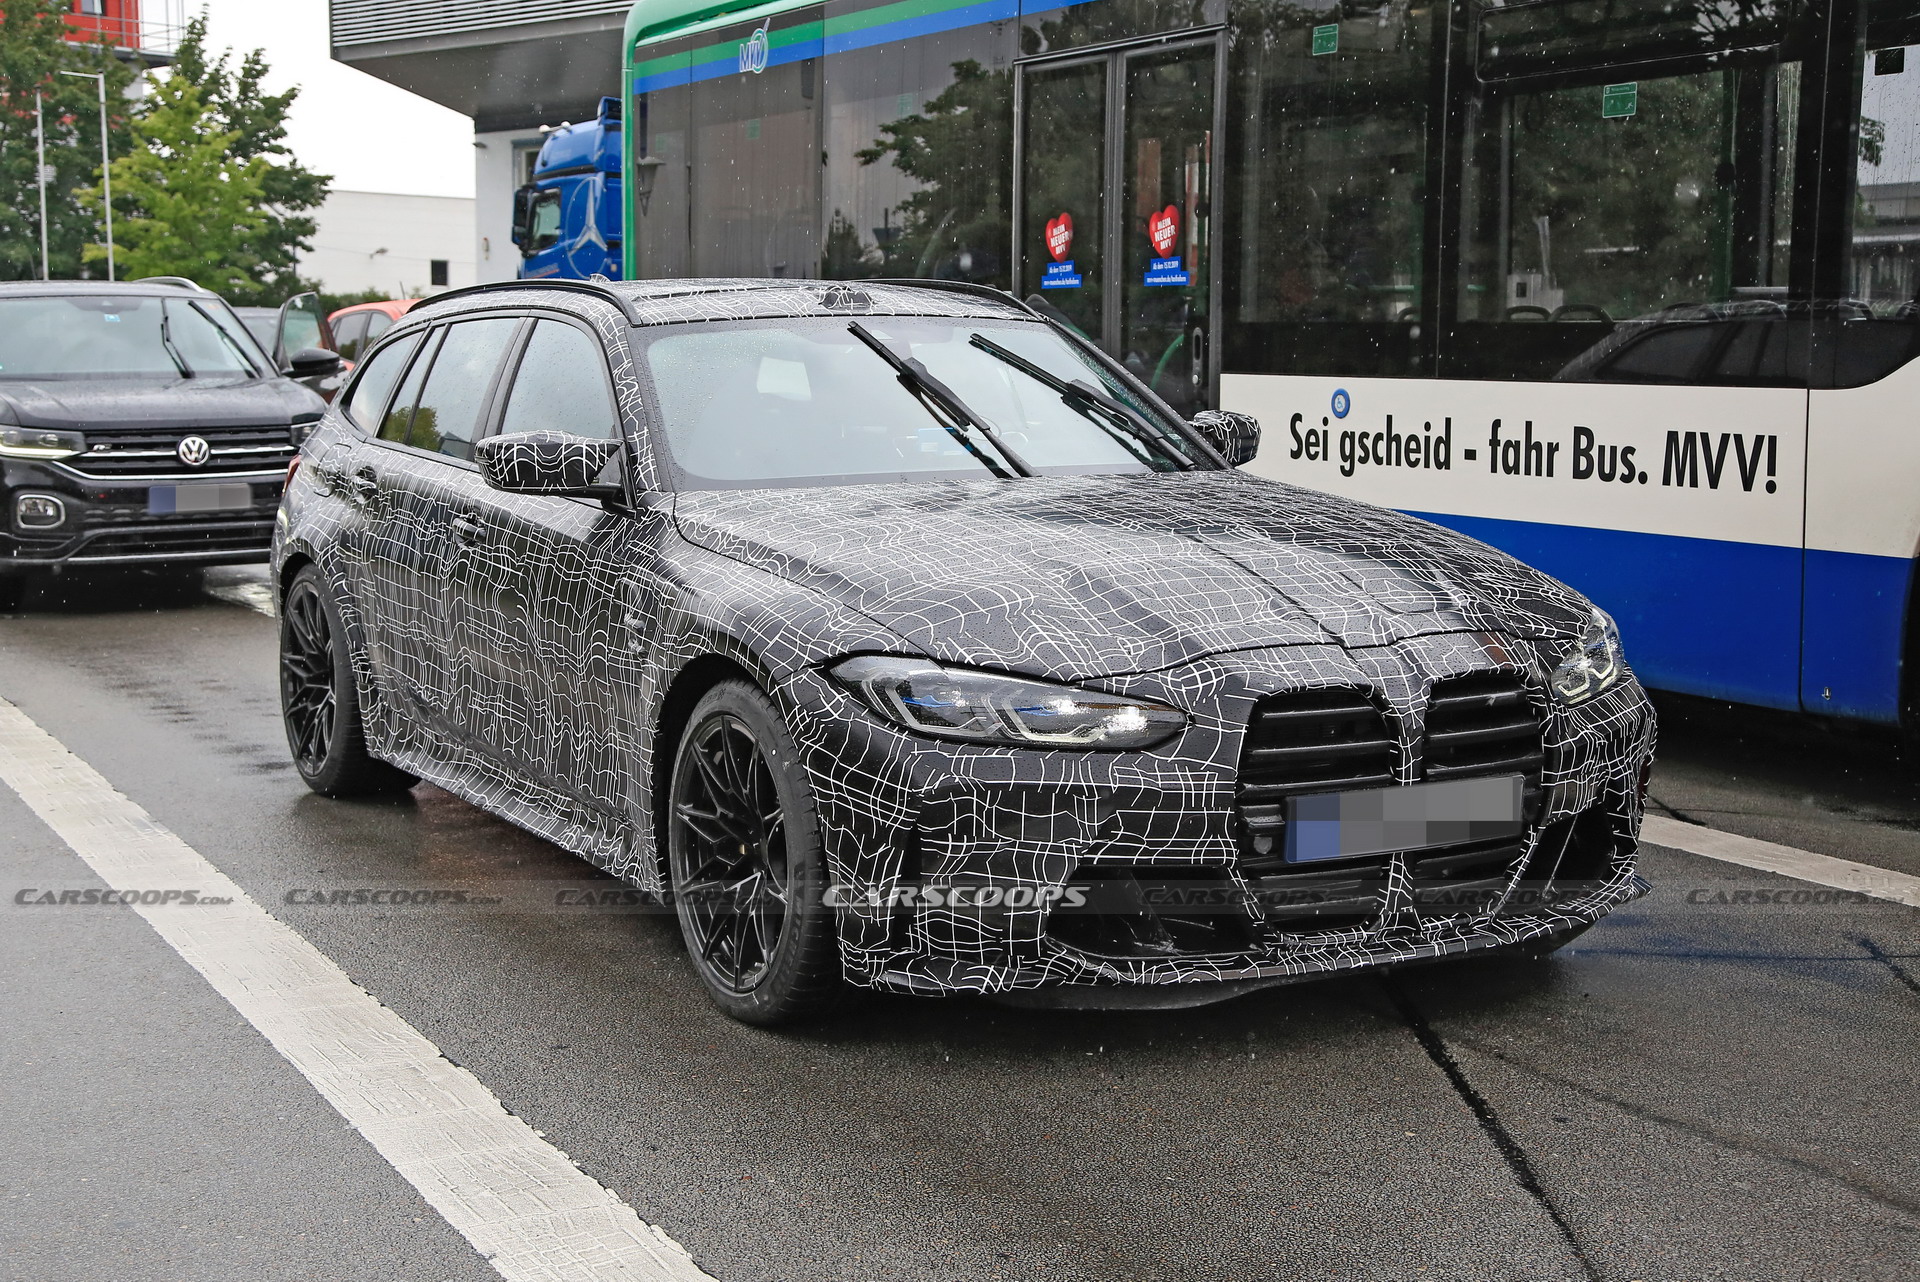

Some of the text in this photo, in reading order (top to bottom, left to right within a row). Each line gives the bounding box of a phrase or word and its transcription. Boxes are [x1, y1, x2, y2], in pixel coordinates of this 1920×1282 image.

[1157, 217, 1171, 230] MEIN
[1050, 231, 1070, 247] NEUER
[1154, 224, 1176, 242] NEUER
[1160, 238, 1171, 250] MVV
[1289, 412, 1329, 462] Sei
[1339, 416, 1452, 477] gscheid
[1488, 418, 1560, 477] fahr
[1572, 425, 1648, 485] Bus.
[1661, 430, 1778, 495] MVV!
